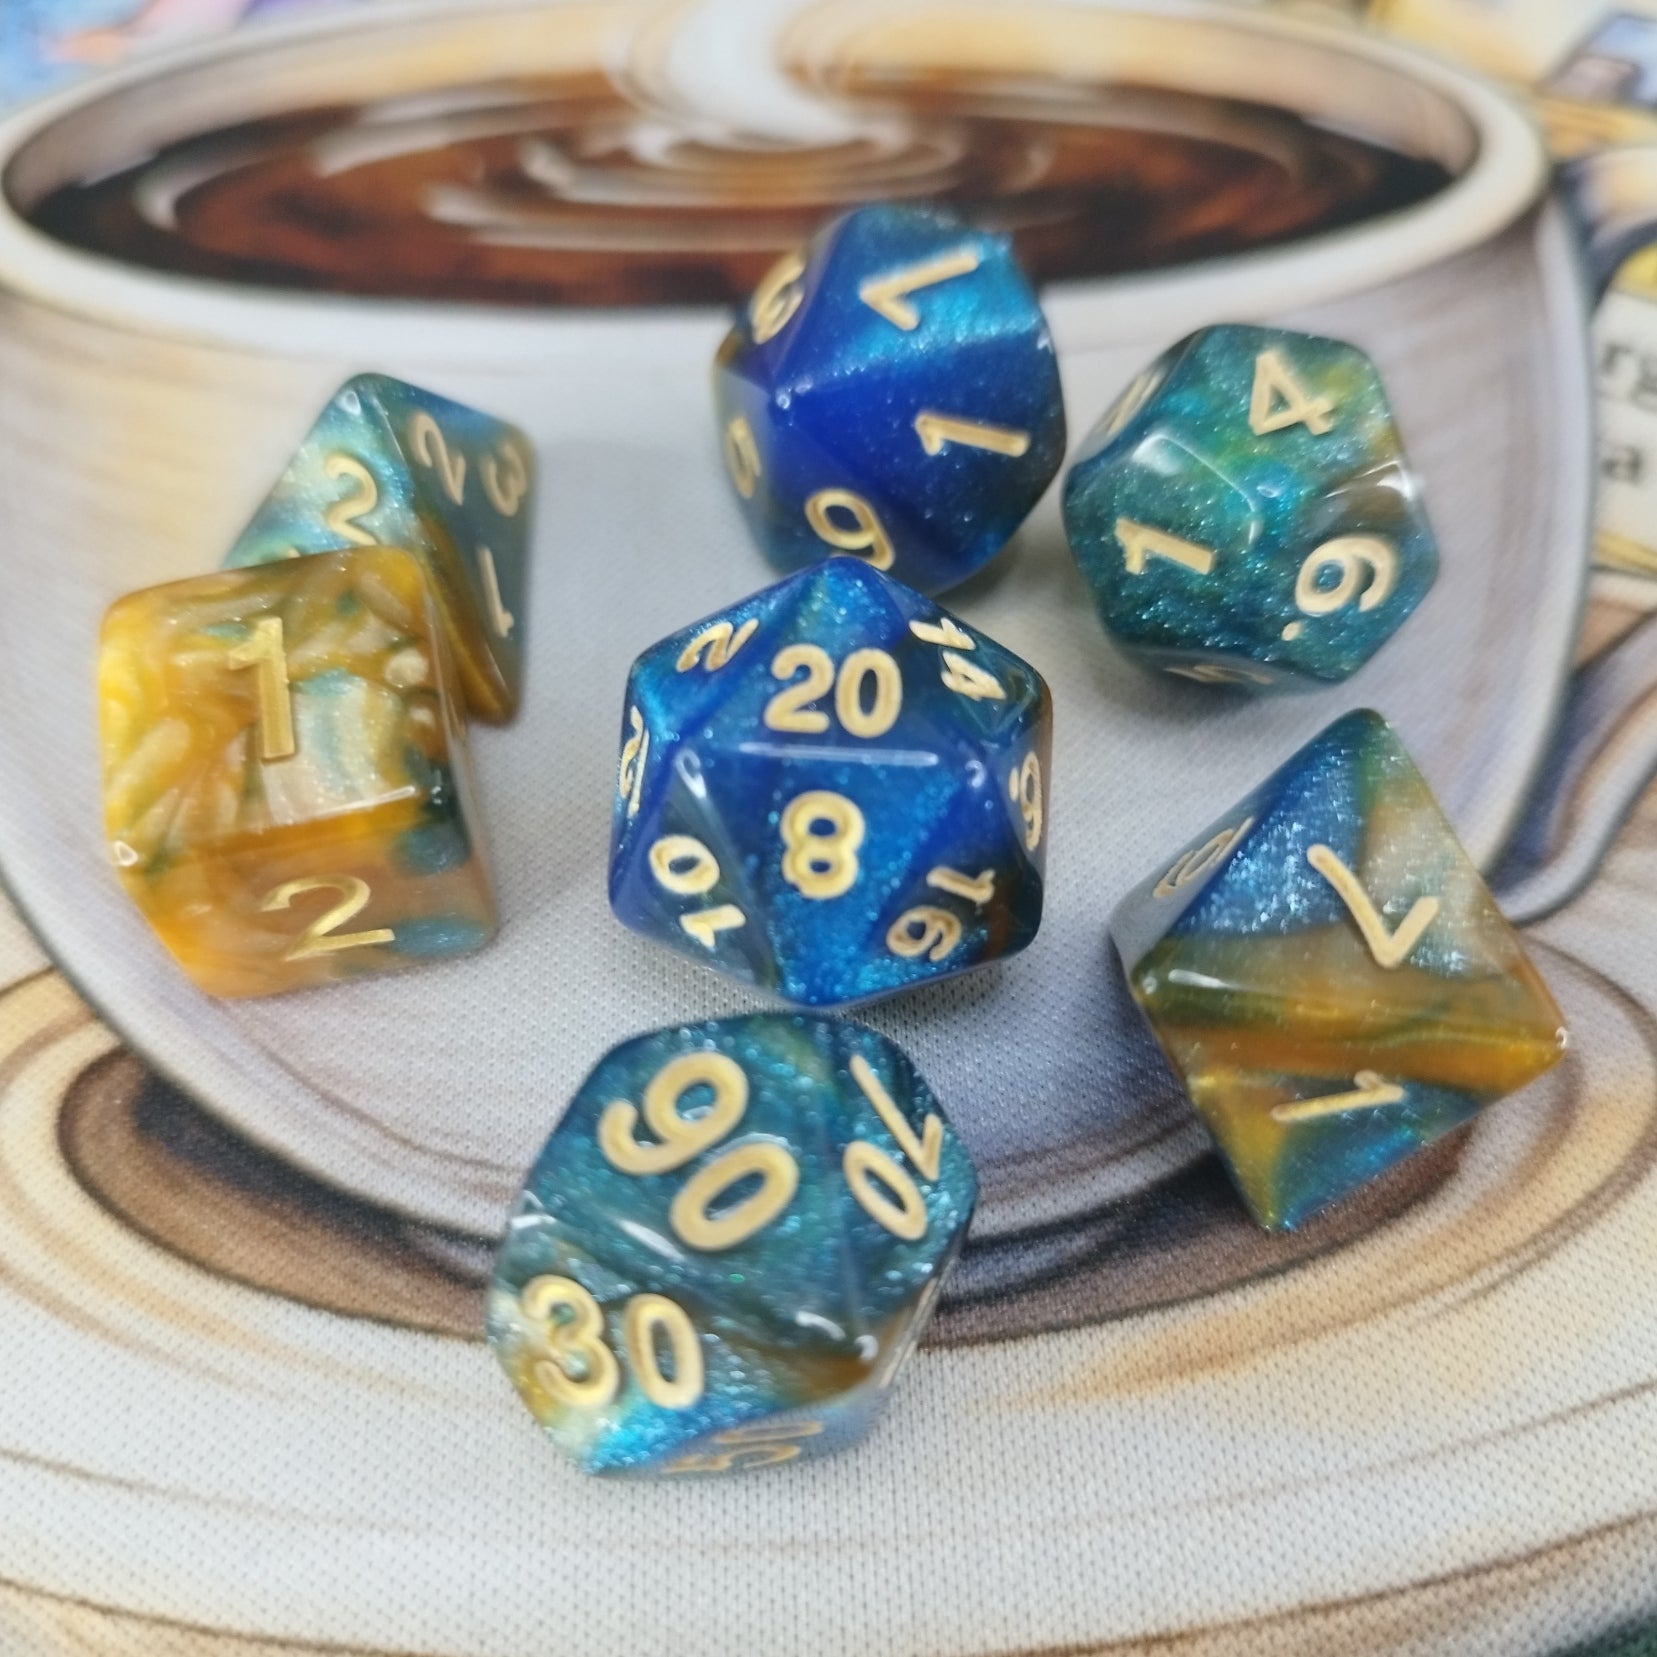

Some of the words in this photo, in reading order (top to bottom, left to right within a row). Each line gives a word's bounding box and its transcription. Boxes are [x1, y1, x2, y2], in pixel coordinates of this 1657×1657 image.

[914, 409, 1031, 458] 1
[1248, 348, 1334, 436] 4
[324, 452, 378, 546] 2
[1115, 517, 1216, 576] 1
[227, 616, 296, 761] 1
[675, 617, 760, 673] 2
[763, 643, 903, 739] 20
[779, 789, 865, 900] 8
[260, 875, 396, 962] 2
[648, 834, 747, 952] 10
[1306, 843, 1440, 969] 7
[1271, 1069, 1405, 1122] 1
[597, 1050, 801, 1252] 90
[520, 1272, 706, 1410] 30
